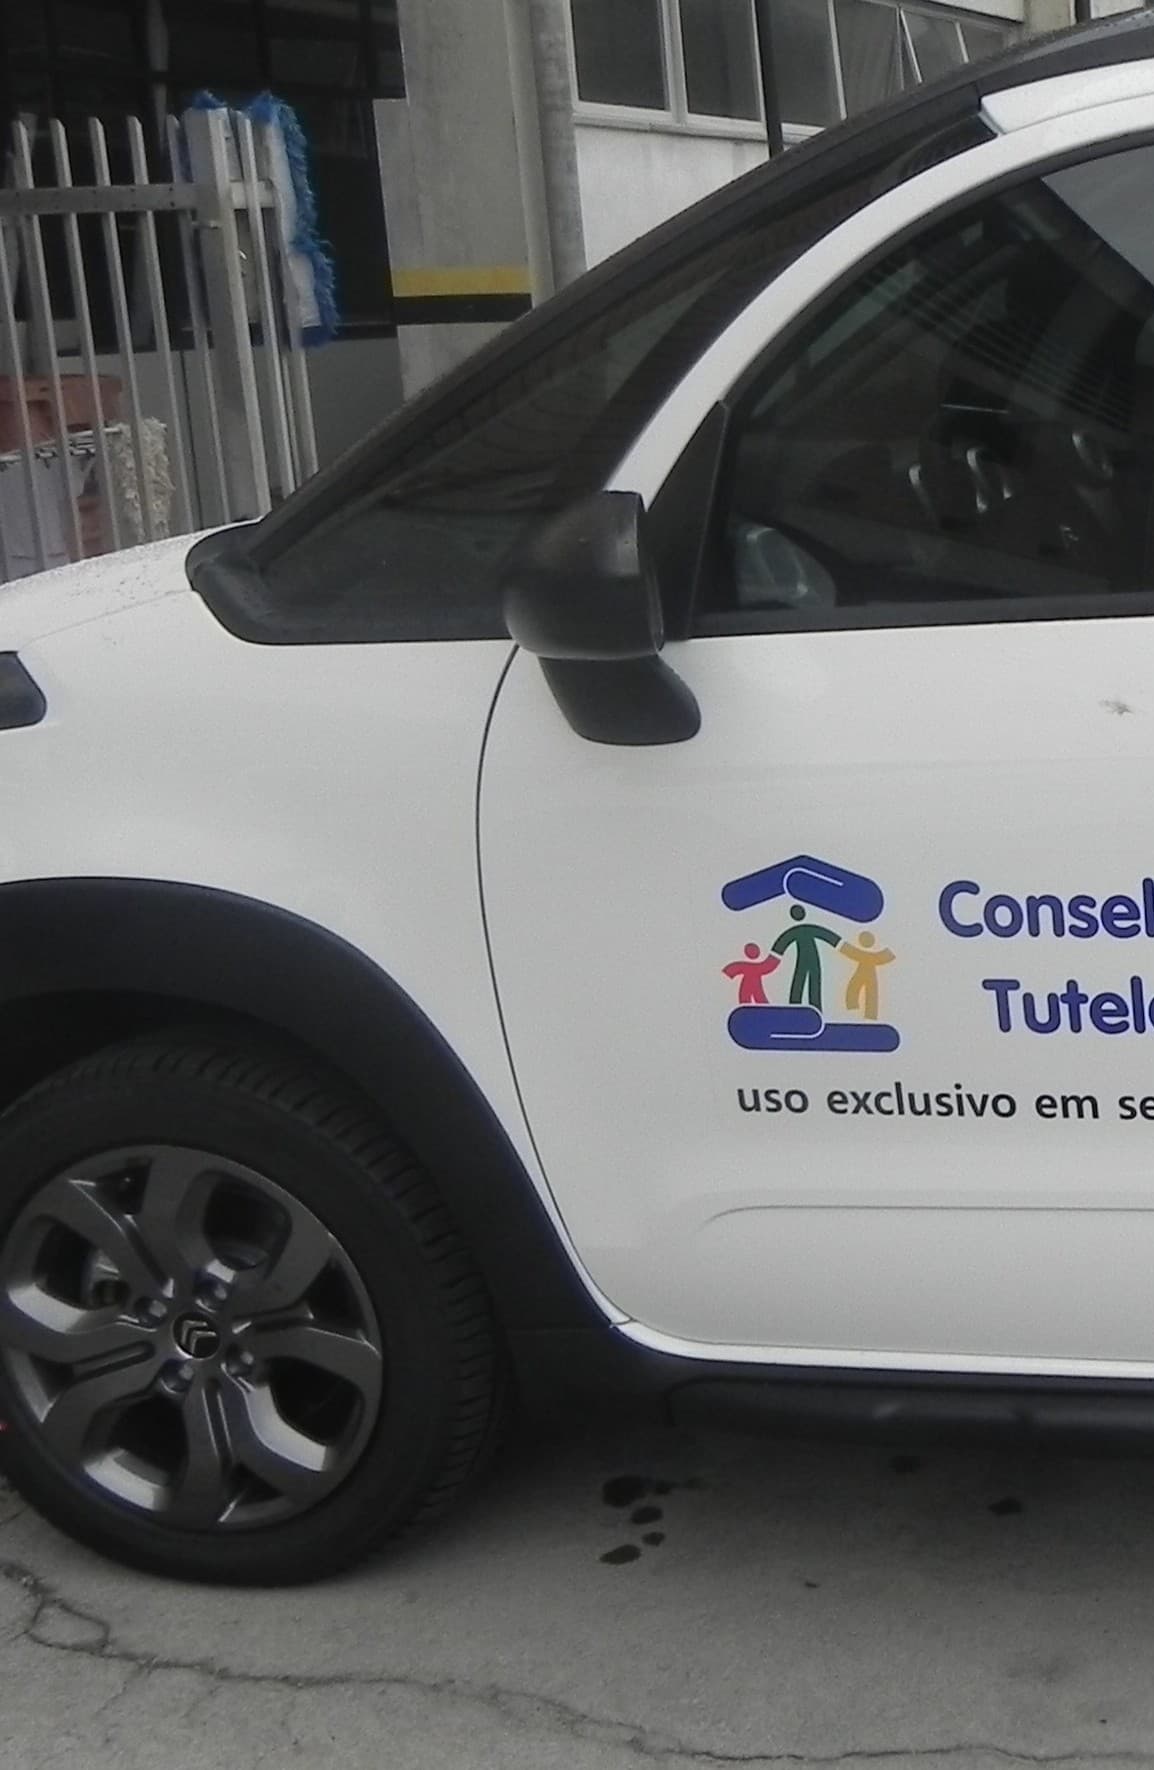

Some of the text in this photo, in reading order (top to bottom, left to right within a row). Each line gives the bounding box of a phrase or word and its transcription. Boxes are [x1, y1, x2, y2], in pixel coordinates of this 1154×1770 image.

[736, 1087, 809, 1114] uso
[826, 1081, 1017, 1119] exclusivo
[1035, 1094, 1100, 1120] em
